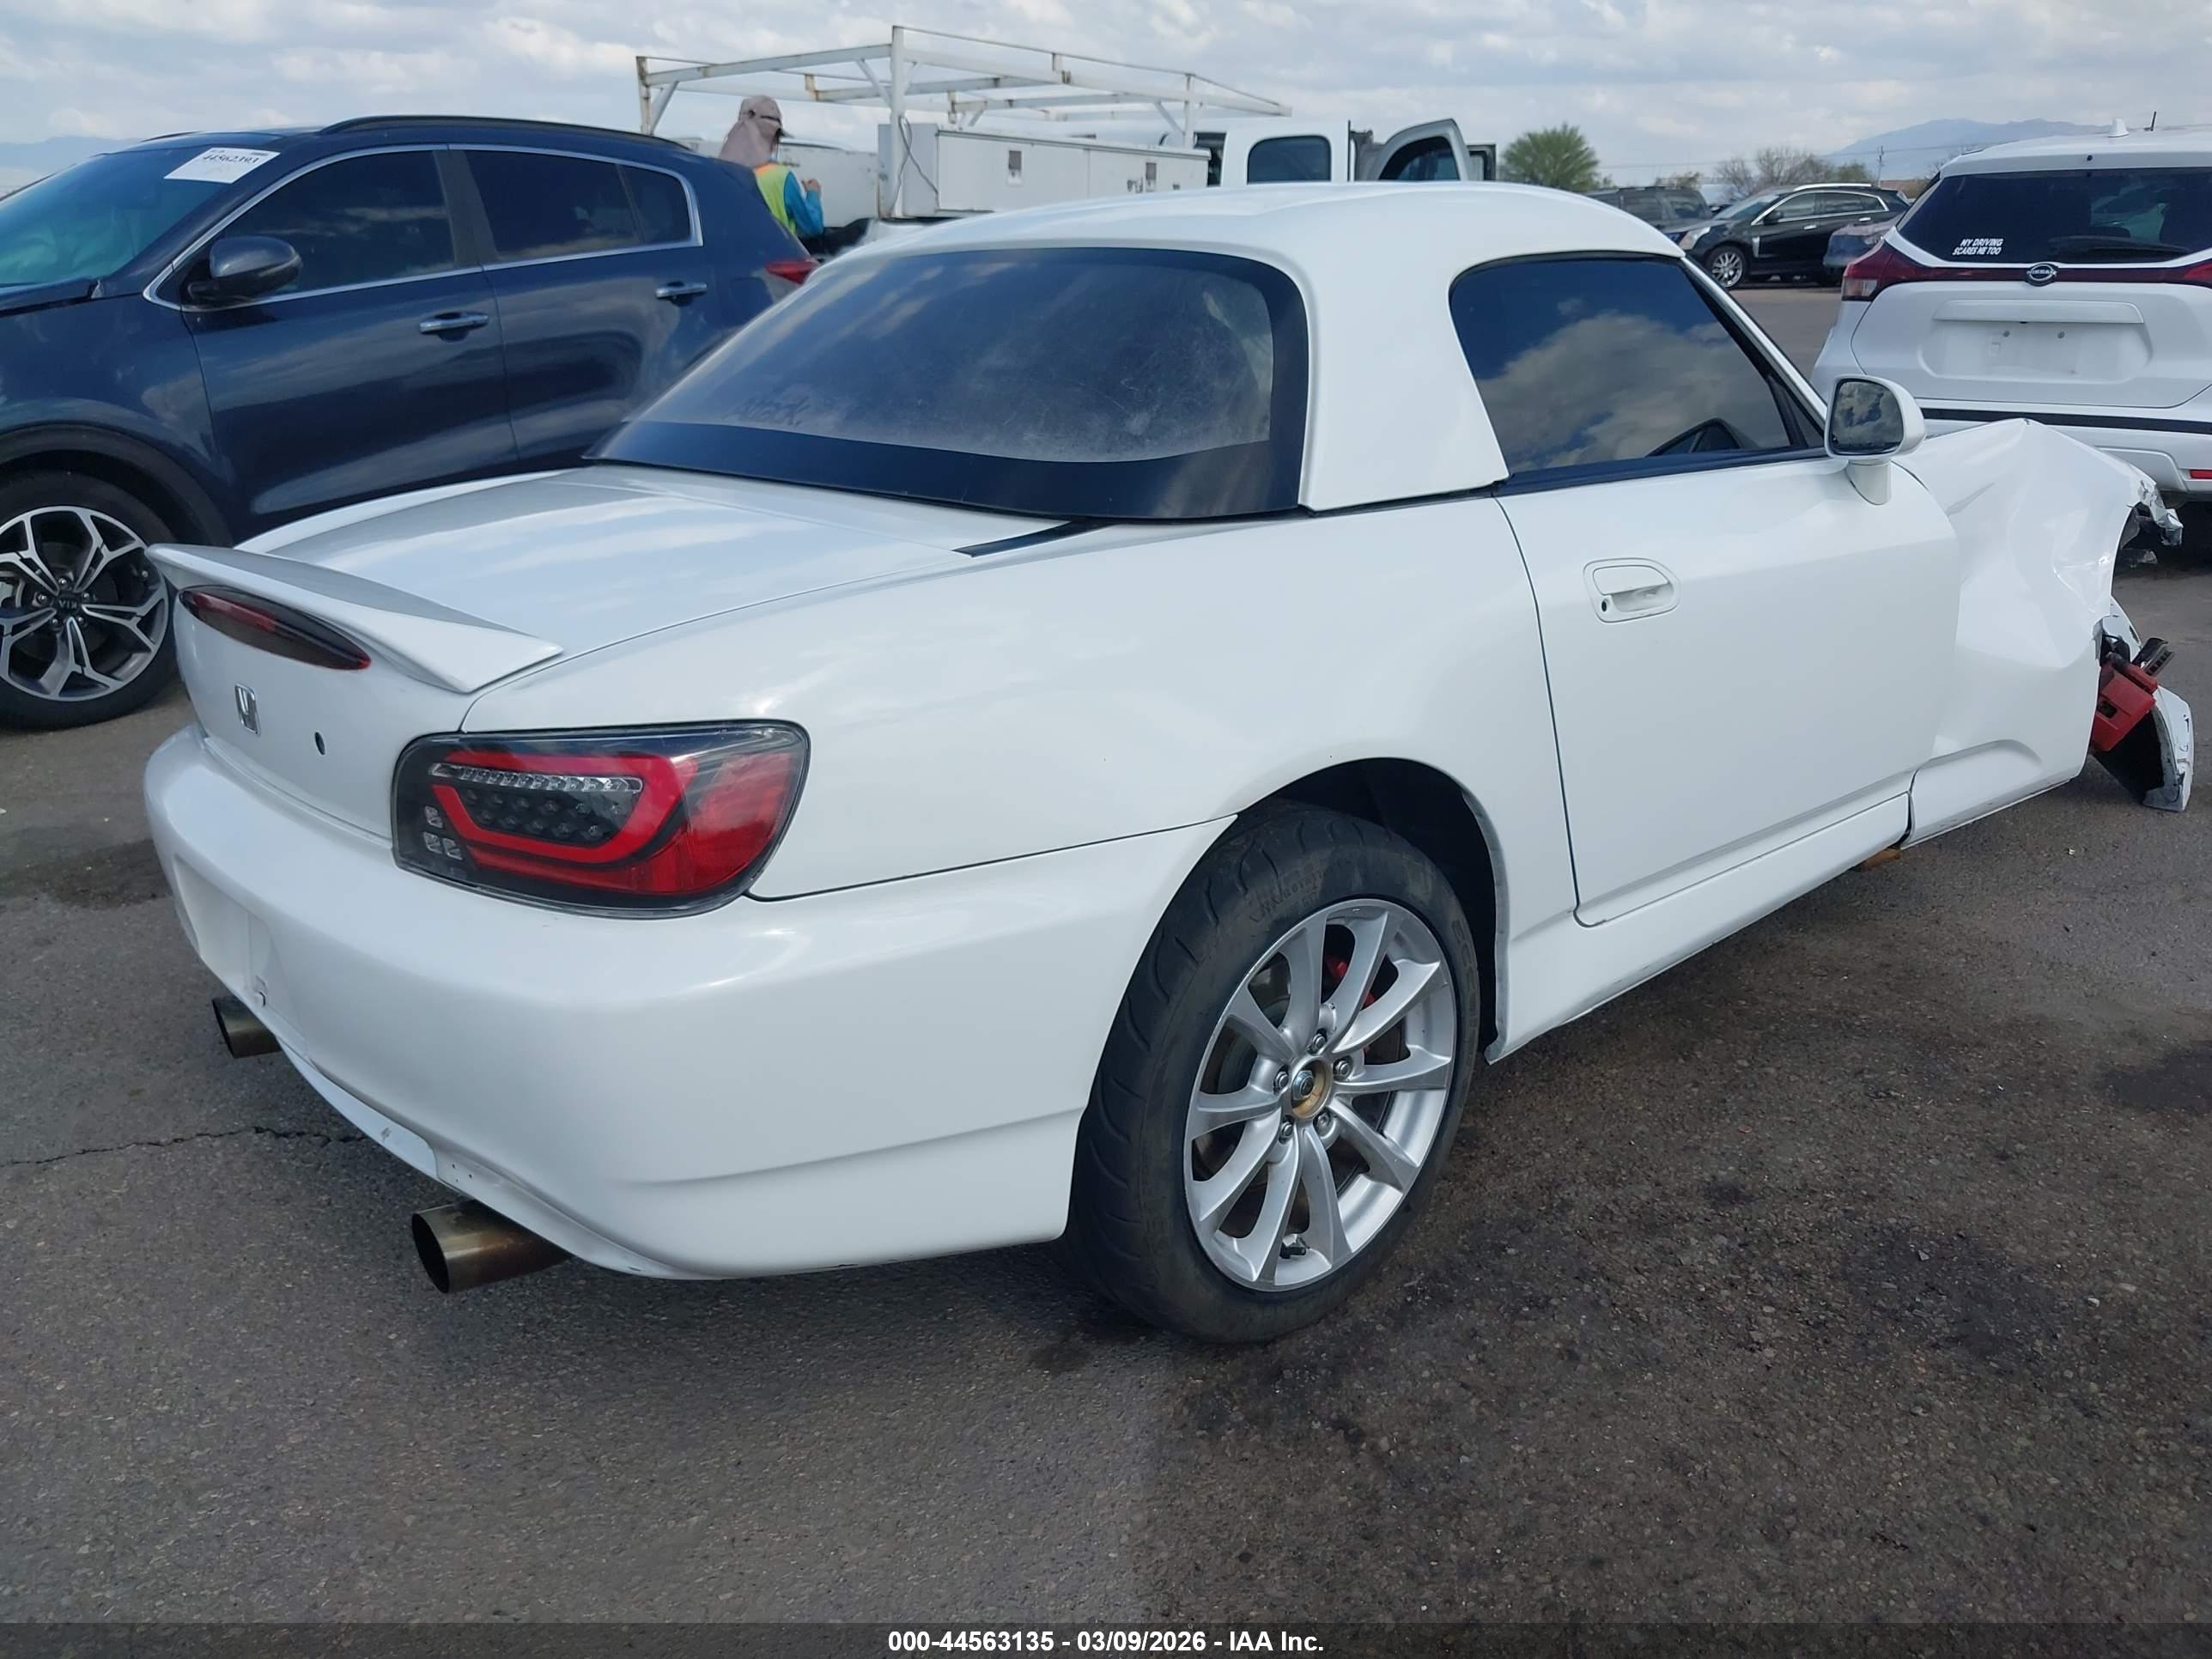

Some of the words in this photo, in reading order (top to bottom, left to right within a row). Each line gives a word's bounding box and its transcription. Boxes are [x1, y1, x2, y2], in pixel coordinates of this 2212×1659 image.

[1960, 239, 1973, 247] MY
[1972, 238, 2004, 246] DRIVING
[1952, 246, 1978, 255] SCARES
[1976, 246, 1988, 255] ME
[1986, 246, 2002, 255] TOO
